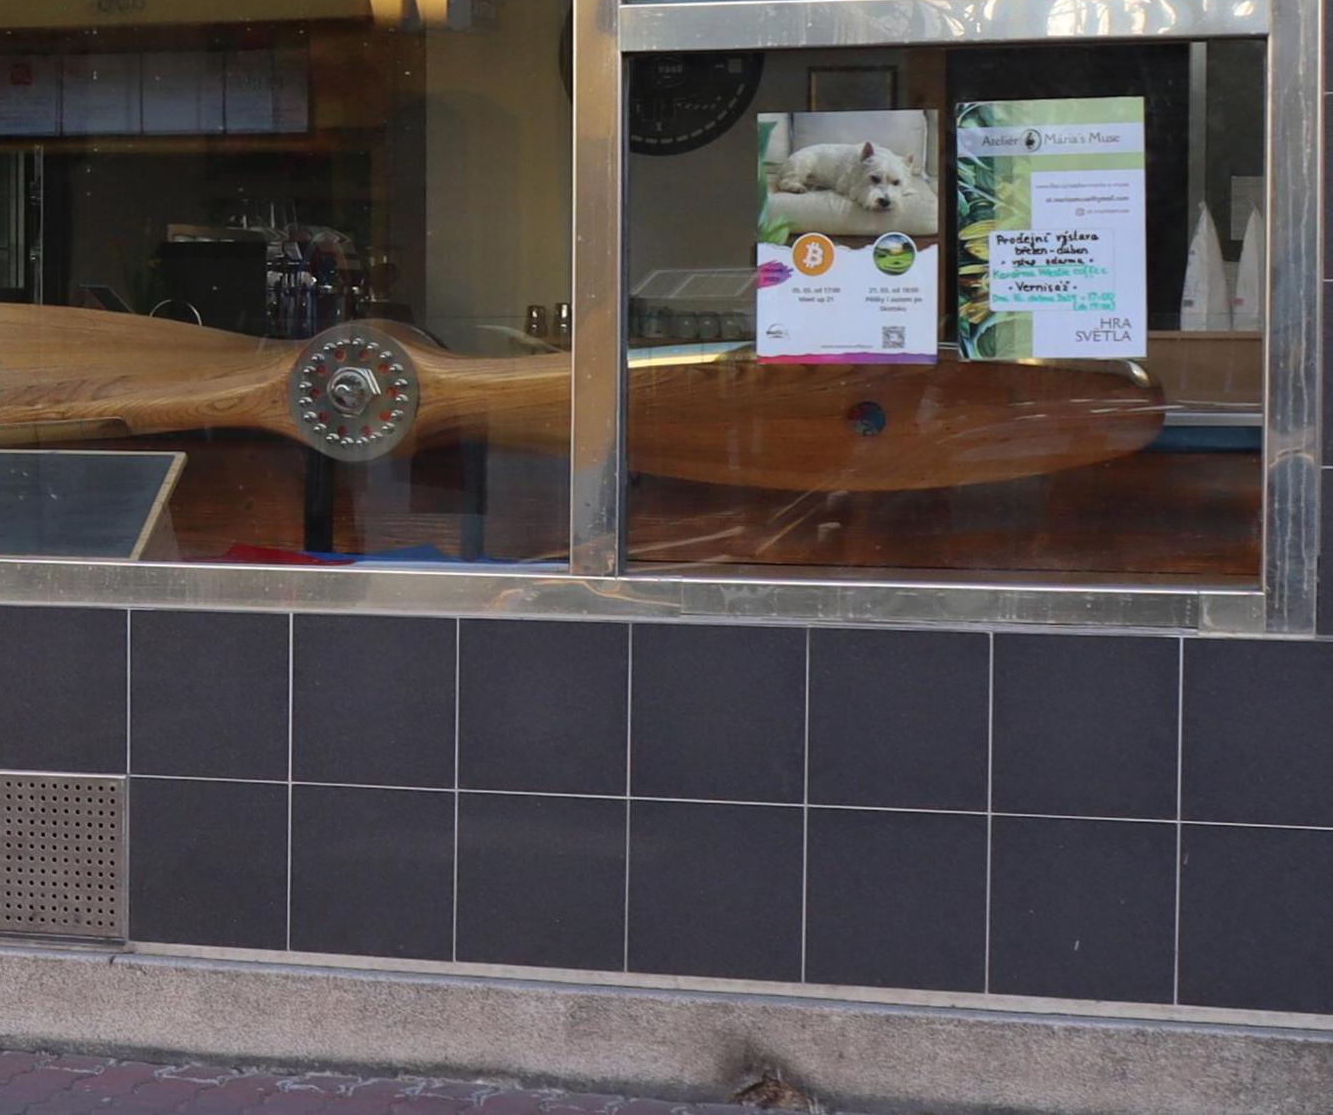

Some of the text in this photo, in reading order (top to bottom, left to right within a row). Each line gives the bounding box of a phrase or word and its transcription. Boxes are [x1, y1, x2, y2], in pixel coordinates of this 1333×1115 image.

[1089, 132, 1121, 144] Muse
[996, 232, 1051, 247] Prodejní
[1100, 317, 1132, 329] HRA
